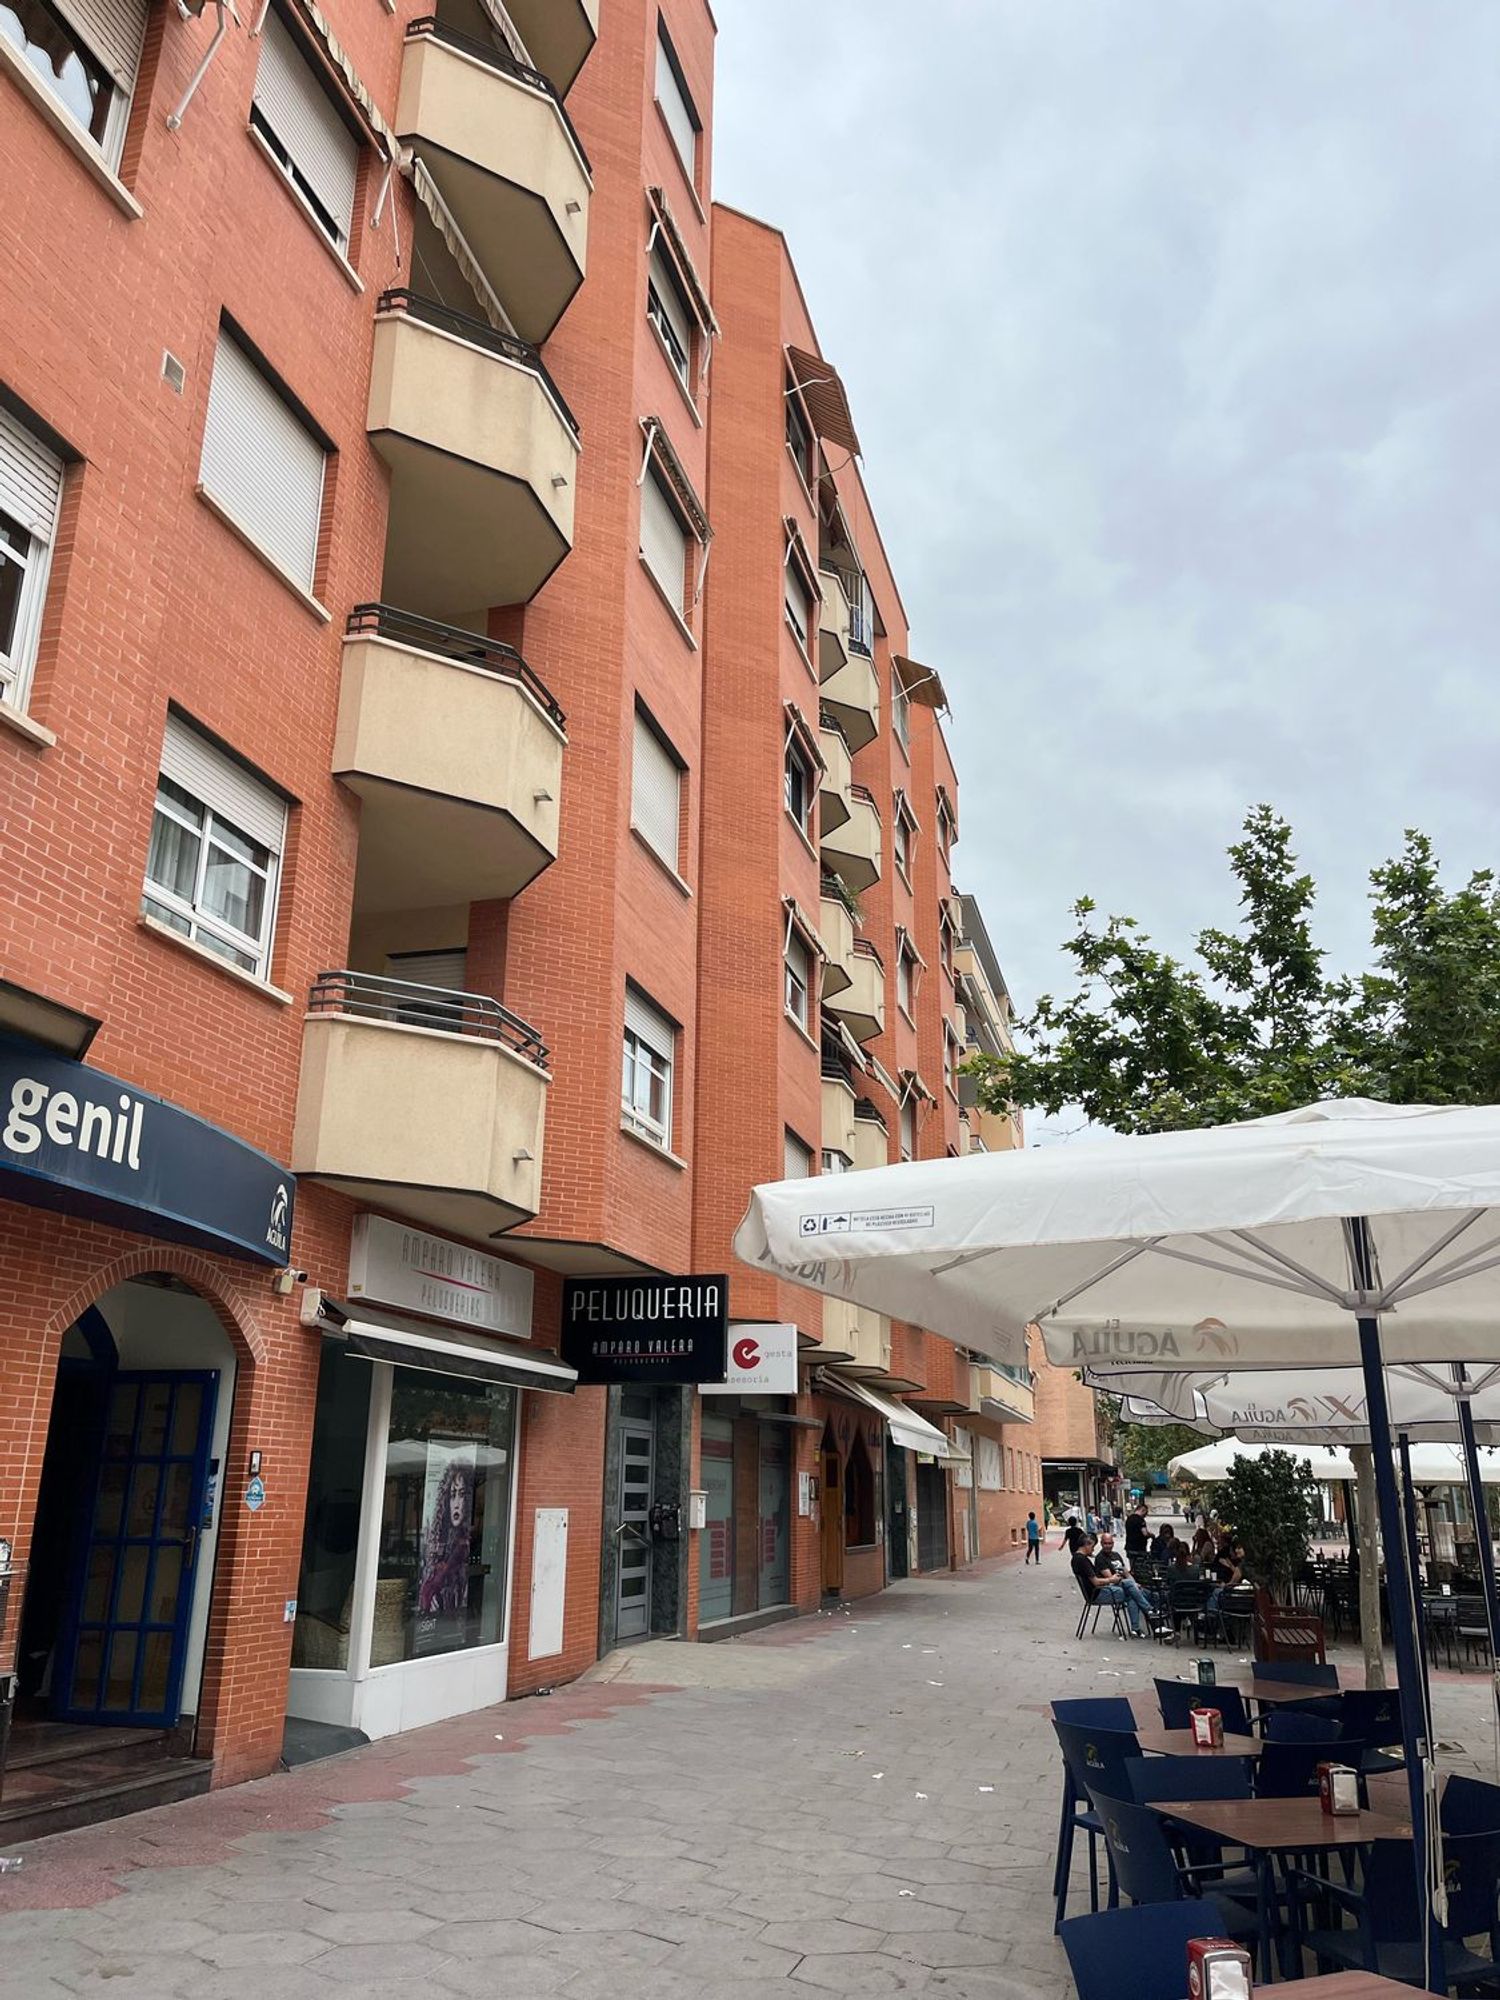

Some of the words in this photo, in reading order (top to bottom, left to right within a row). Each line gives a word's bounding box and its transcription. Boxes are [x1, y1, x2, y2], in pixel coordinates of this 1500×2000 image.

[2, 1078, 145, 1171] genil
[402, 1233, 453, 1276] AMPARO
[459, 1249, 501, 1290] VALERA
[571, 1285, 719, 1322] PELUQUERIA
[592, 1340, 640, 1355] AMPARO
[648, 1338, 694, 1354] VALERA
